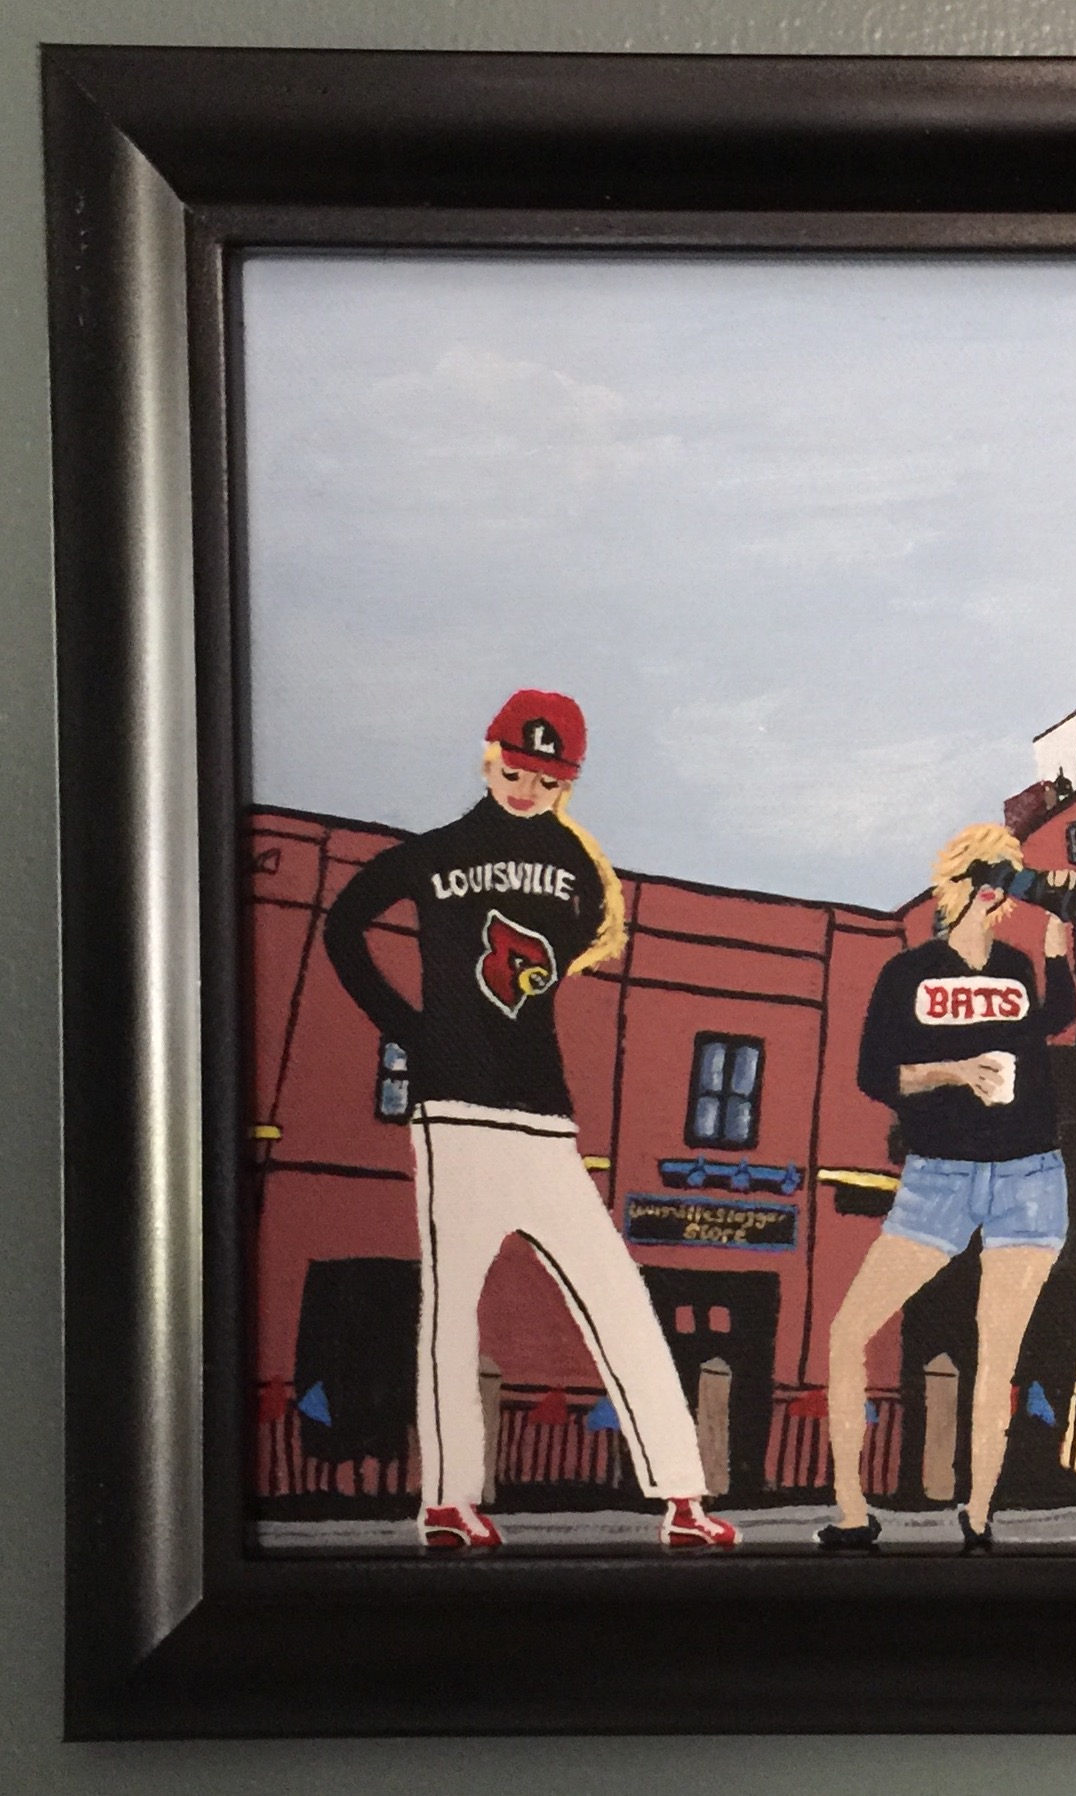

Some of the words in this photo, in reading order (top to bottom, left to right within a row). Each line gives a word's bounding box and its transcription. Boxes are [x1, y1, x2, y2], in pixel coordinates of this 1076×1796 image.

[533, 726, 555, 754] L
[430, 860, 576, 902] LOUISVILLE
[923, 984, 1024, 1019] BATS
